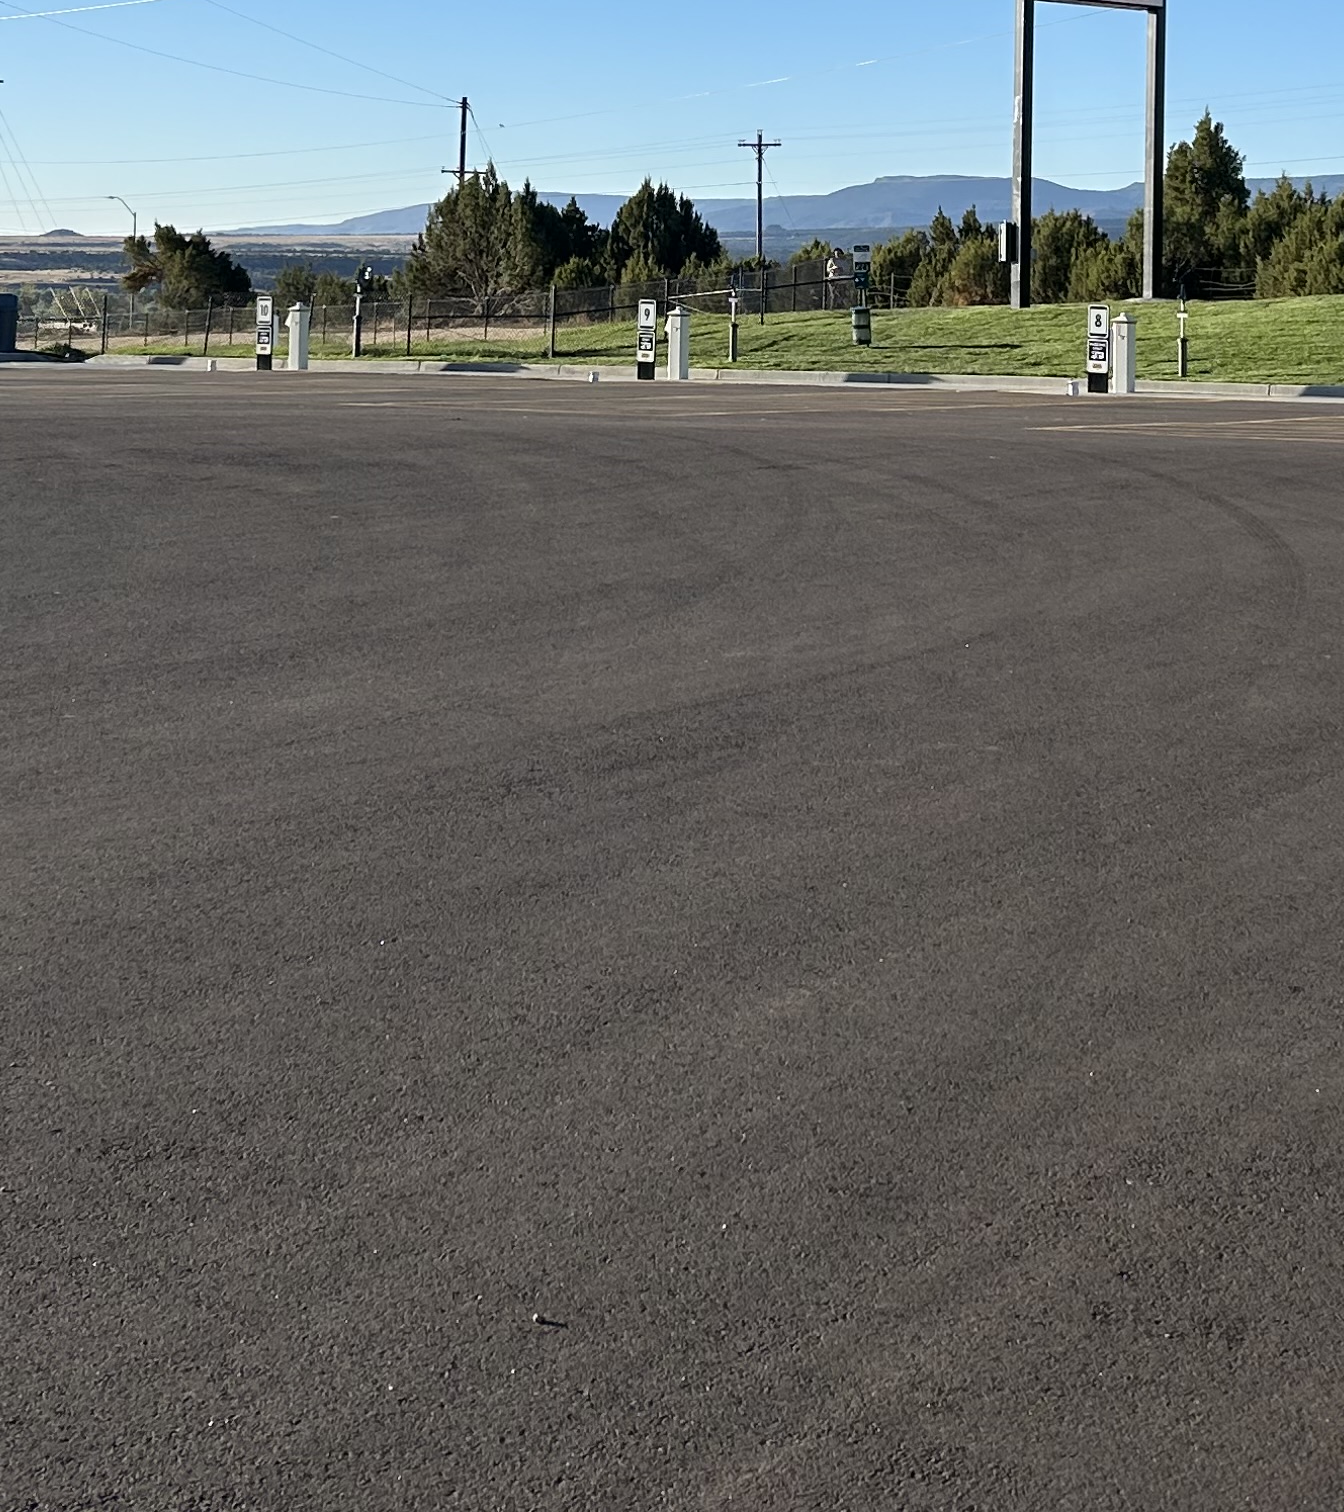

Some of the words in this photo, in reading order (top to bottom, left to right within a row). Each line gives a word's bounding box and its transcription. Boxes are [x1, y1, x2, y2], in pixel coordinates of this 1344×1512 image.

[260, 304, 269, 316] 10
[644, 308, 651, 321] 9
[1094, 313, 1102, 328] 8
